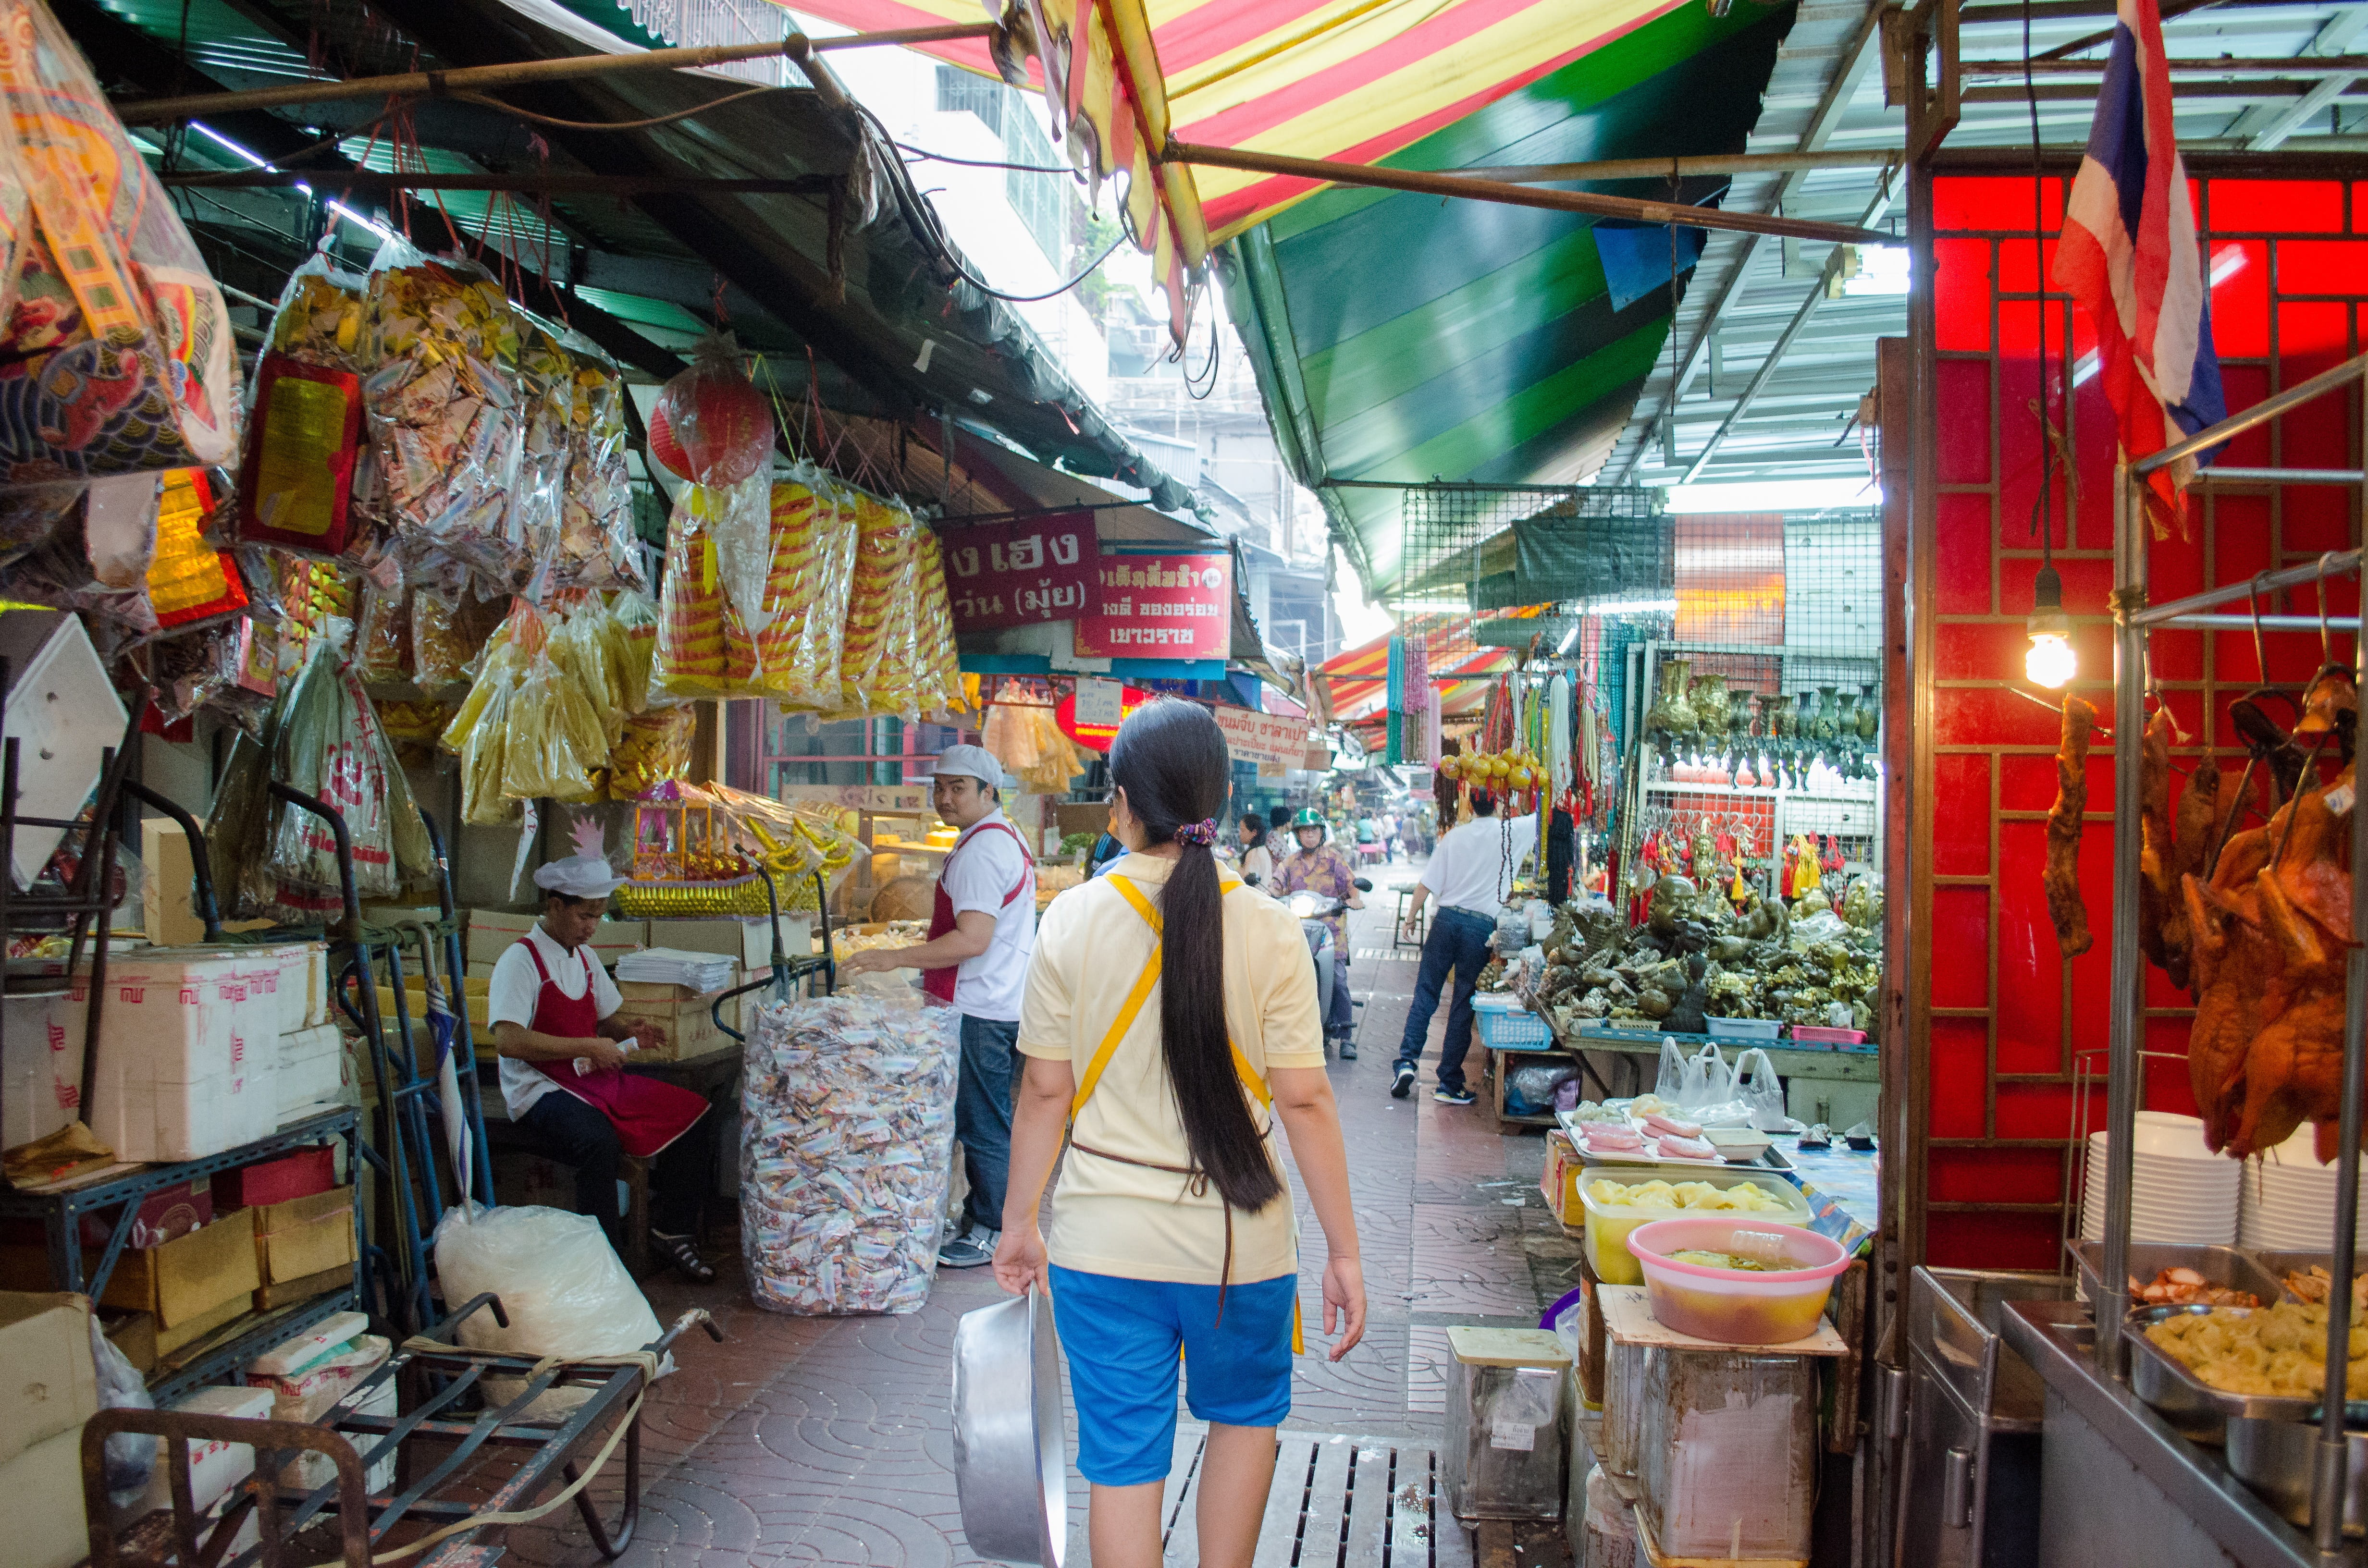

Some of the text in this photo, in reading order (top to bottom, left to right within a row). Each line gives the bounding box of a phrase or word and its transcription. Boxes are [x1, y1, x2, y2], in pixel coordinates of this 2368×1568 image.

[1014, 578, 1085, 619] (มุ้ย)
[1139, 597, 1219, 617] ของอร่อย
[1110, 627, 1195, 644] เยาวราช
[1218, 713, 1255, 733] ขนมจีบ
